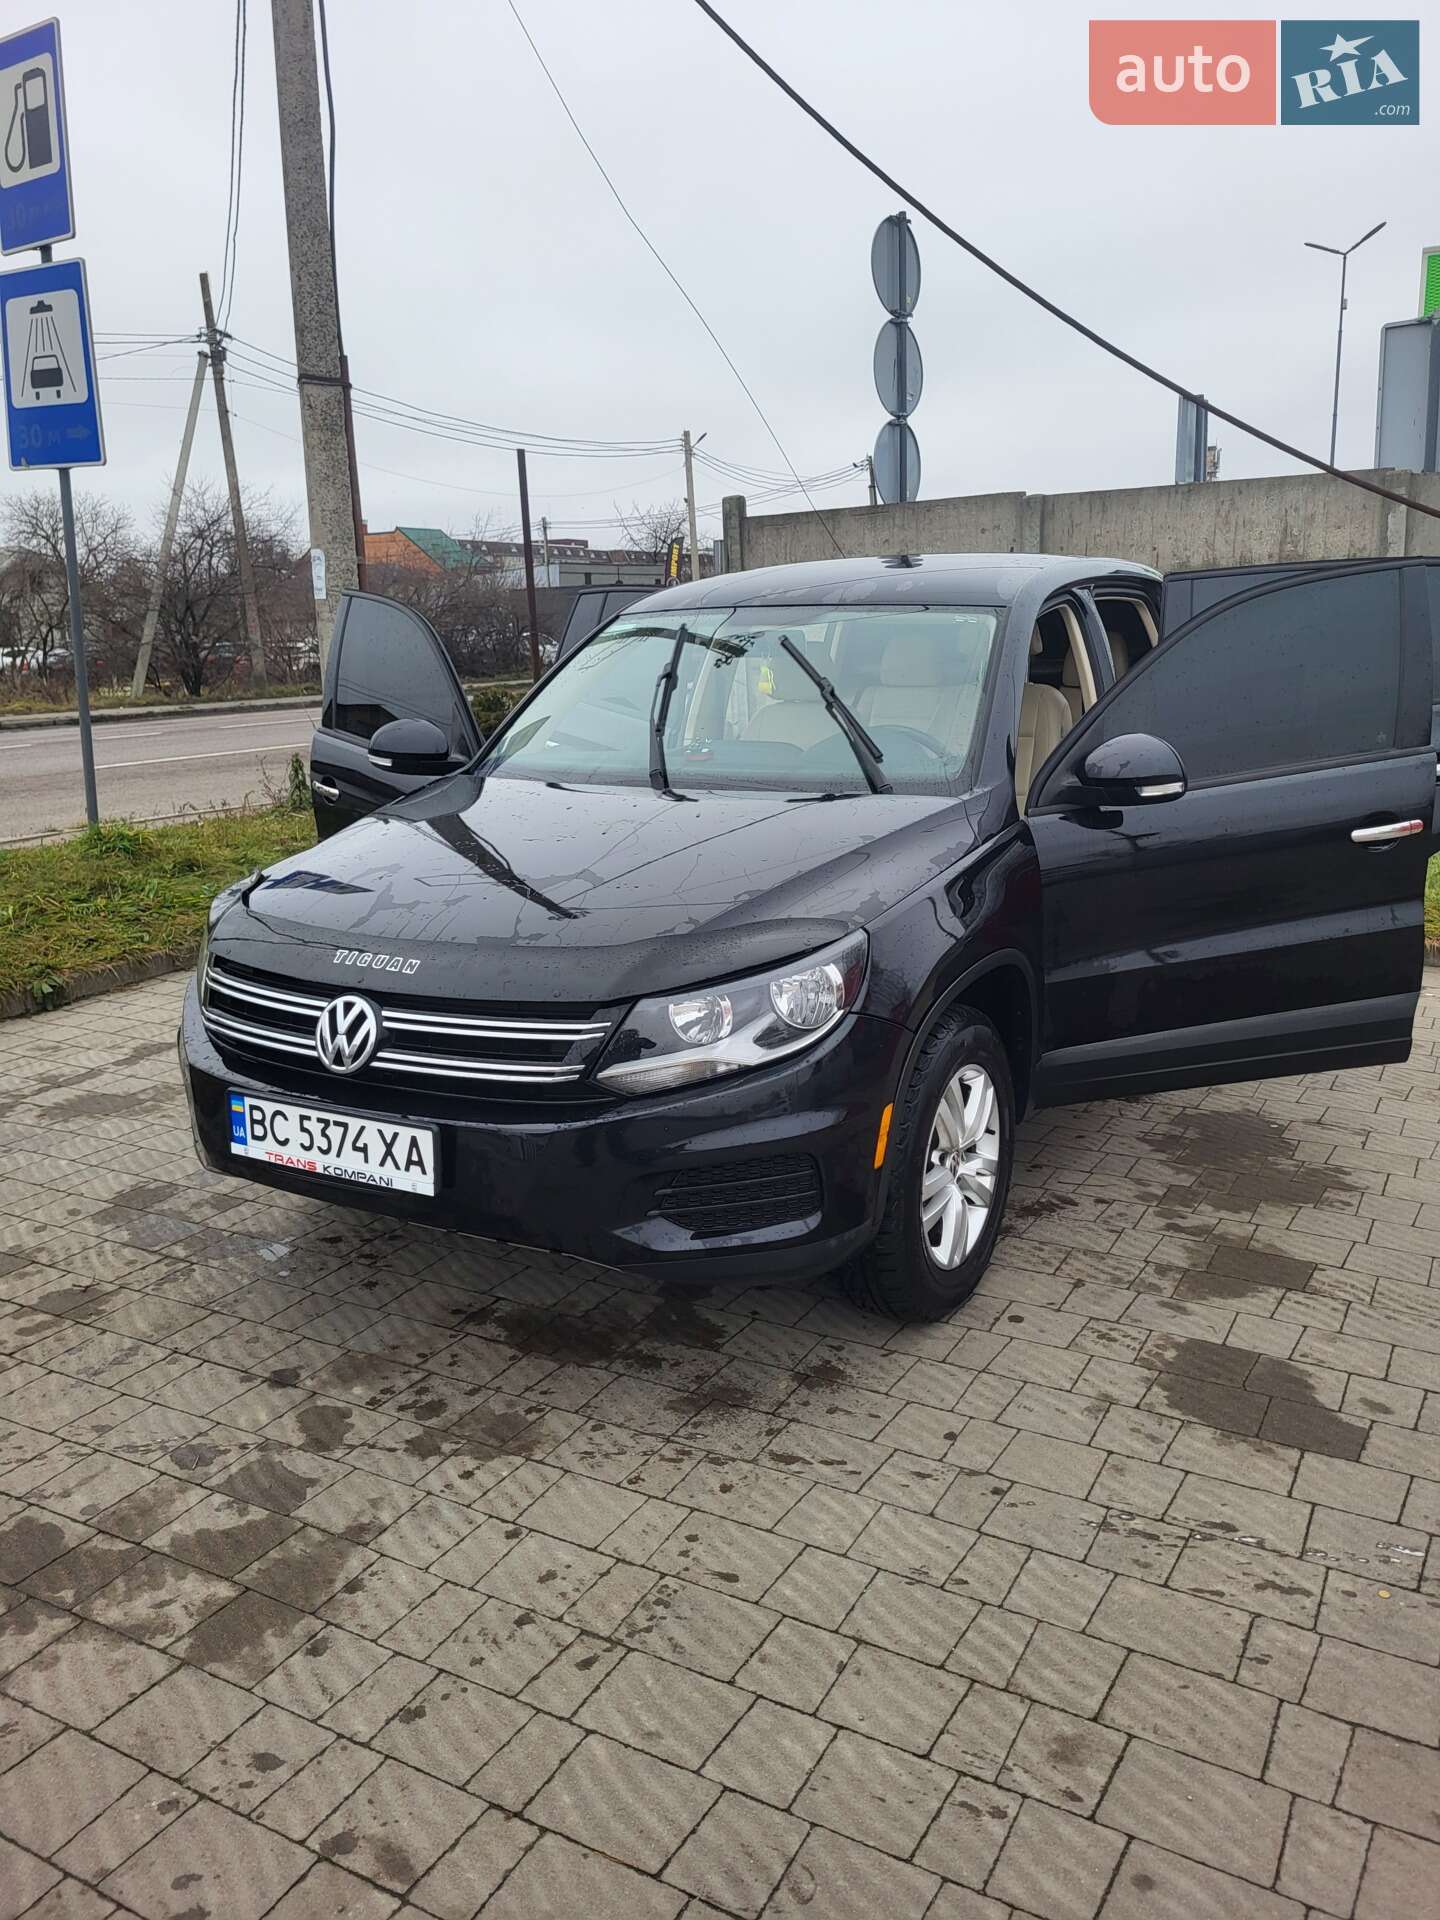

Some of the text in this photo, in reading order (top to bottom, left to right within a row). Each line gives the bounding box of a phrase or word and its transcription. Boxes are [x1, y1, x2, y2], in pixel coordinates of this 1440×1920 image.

[17, 423, 43, 449] 30
[332, 949, 421, 975] TIGUAN
[232, 1125, 246, 1139] UA
[248, 1103, 428, 1176] BC 5374 XA
[264, 1151, 393, 1187] TRANS KOMPANI
